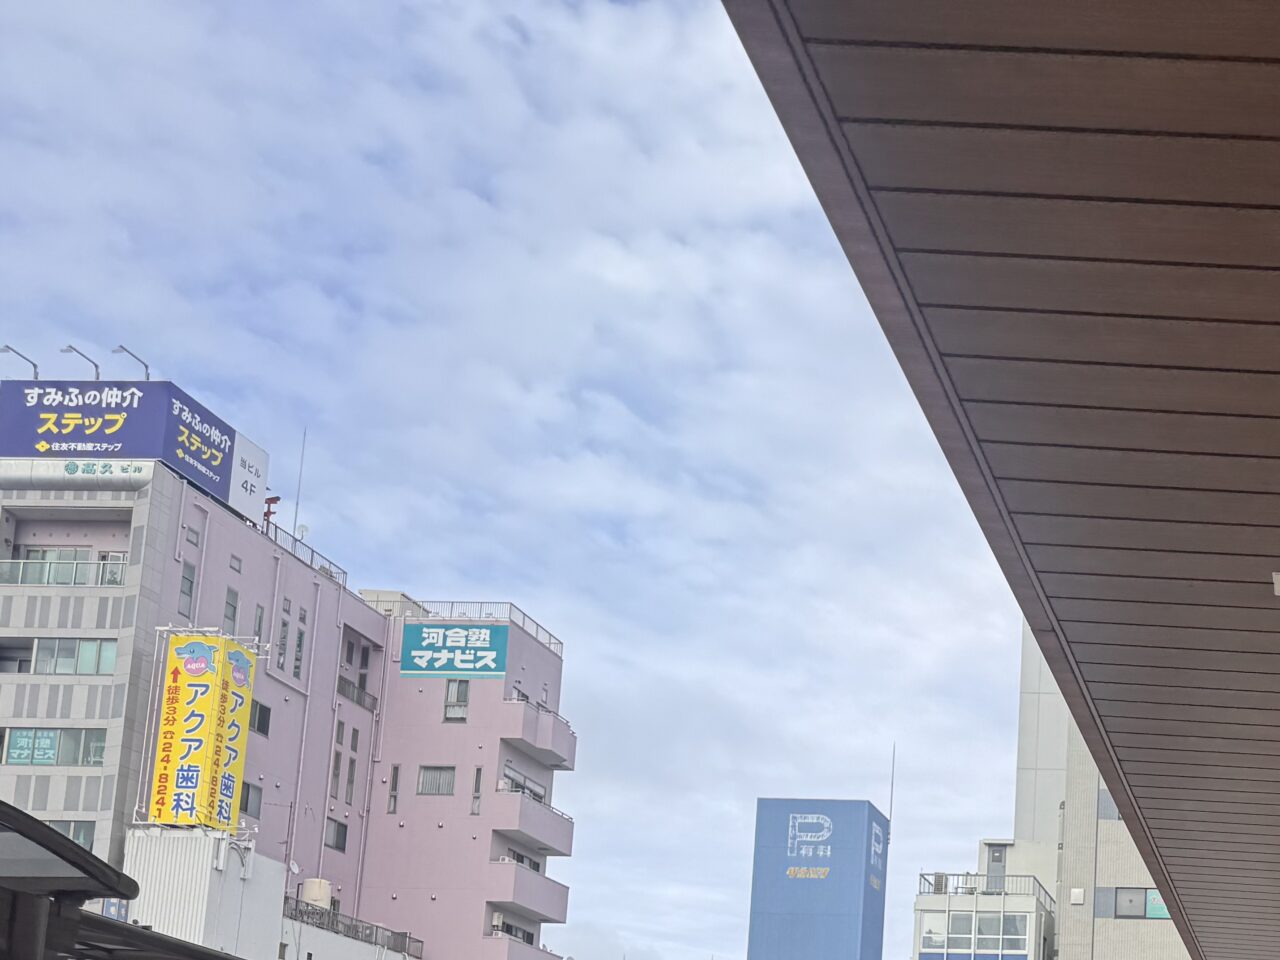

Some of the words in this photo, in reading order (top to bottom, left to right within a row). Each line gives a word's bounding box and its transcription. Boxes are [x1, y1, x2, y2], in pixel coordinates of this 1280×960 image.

[24, 387, 143, 408] すみふの仲介
[36, 412, 127, 435] ステップ
[171, 398, 232, 453] すみふの仲介
[51, 442, 122, 451] 住友不動産ステップ
[177, 425, 223, 466] ステップ
[239, 456, 261, 479] 当ビル
[240, 480, 257, 496] 4F
[421, 627, 490, 647] 河合塾
[186, 662, 206, 670] AQUA
[411, 649, 497, 669] マナビス
[163, 685, 181, 727] 徒歩3分
[171, 682, 210, 819] アクア歯科
[216, 691, 245, 826] アクア歯科
[788, 813, 832, 856] P
